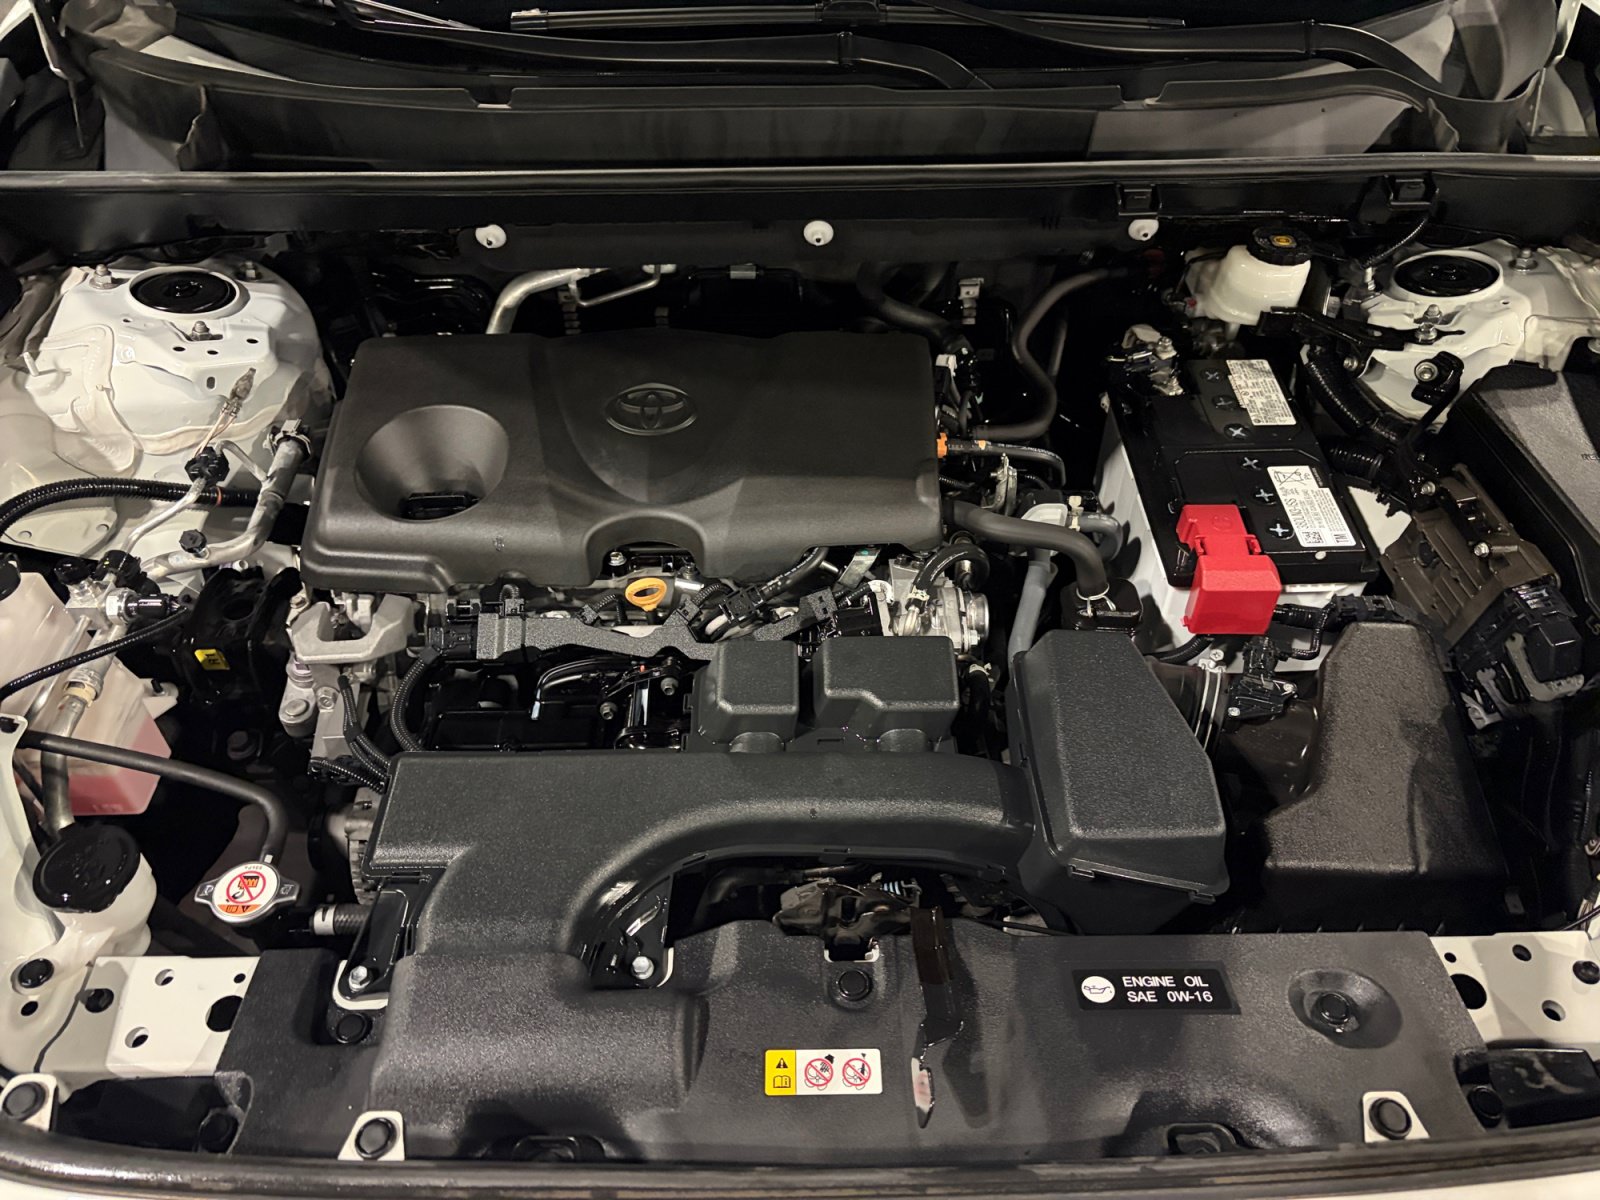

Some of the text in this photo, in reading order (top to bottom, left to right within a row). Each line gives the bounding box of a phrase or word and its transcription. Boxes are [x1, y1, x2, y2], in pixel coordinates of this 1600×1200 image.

[1122, 975, 1209, 987] ENGINE OIL
[1127, 990, 1213, 1003] SAE 0W-16
